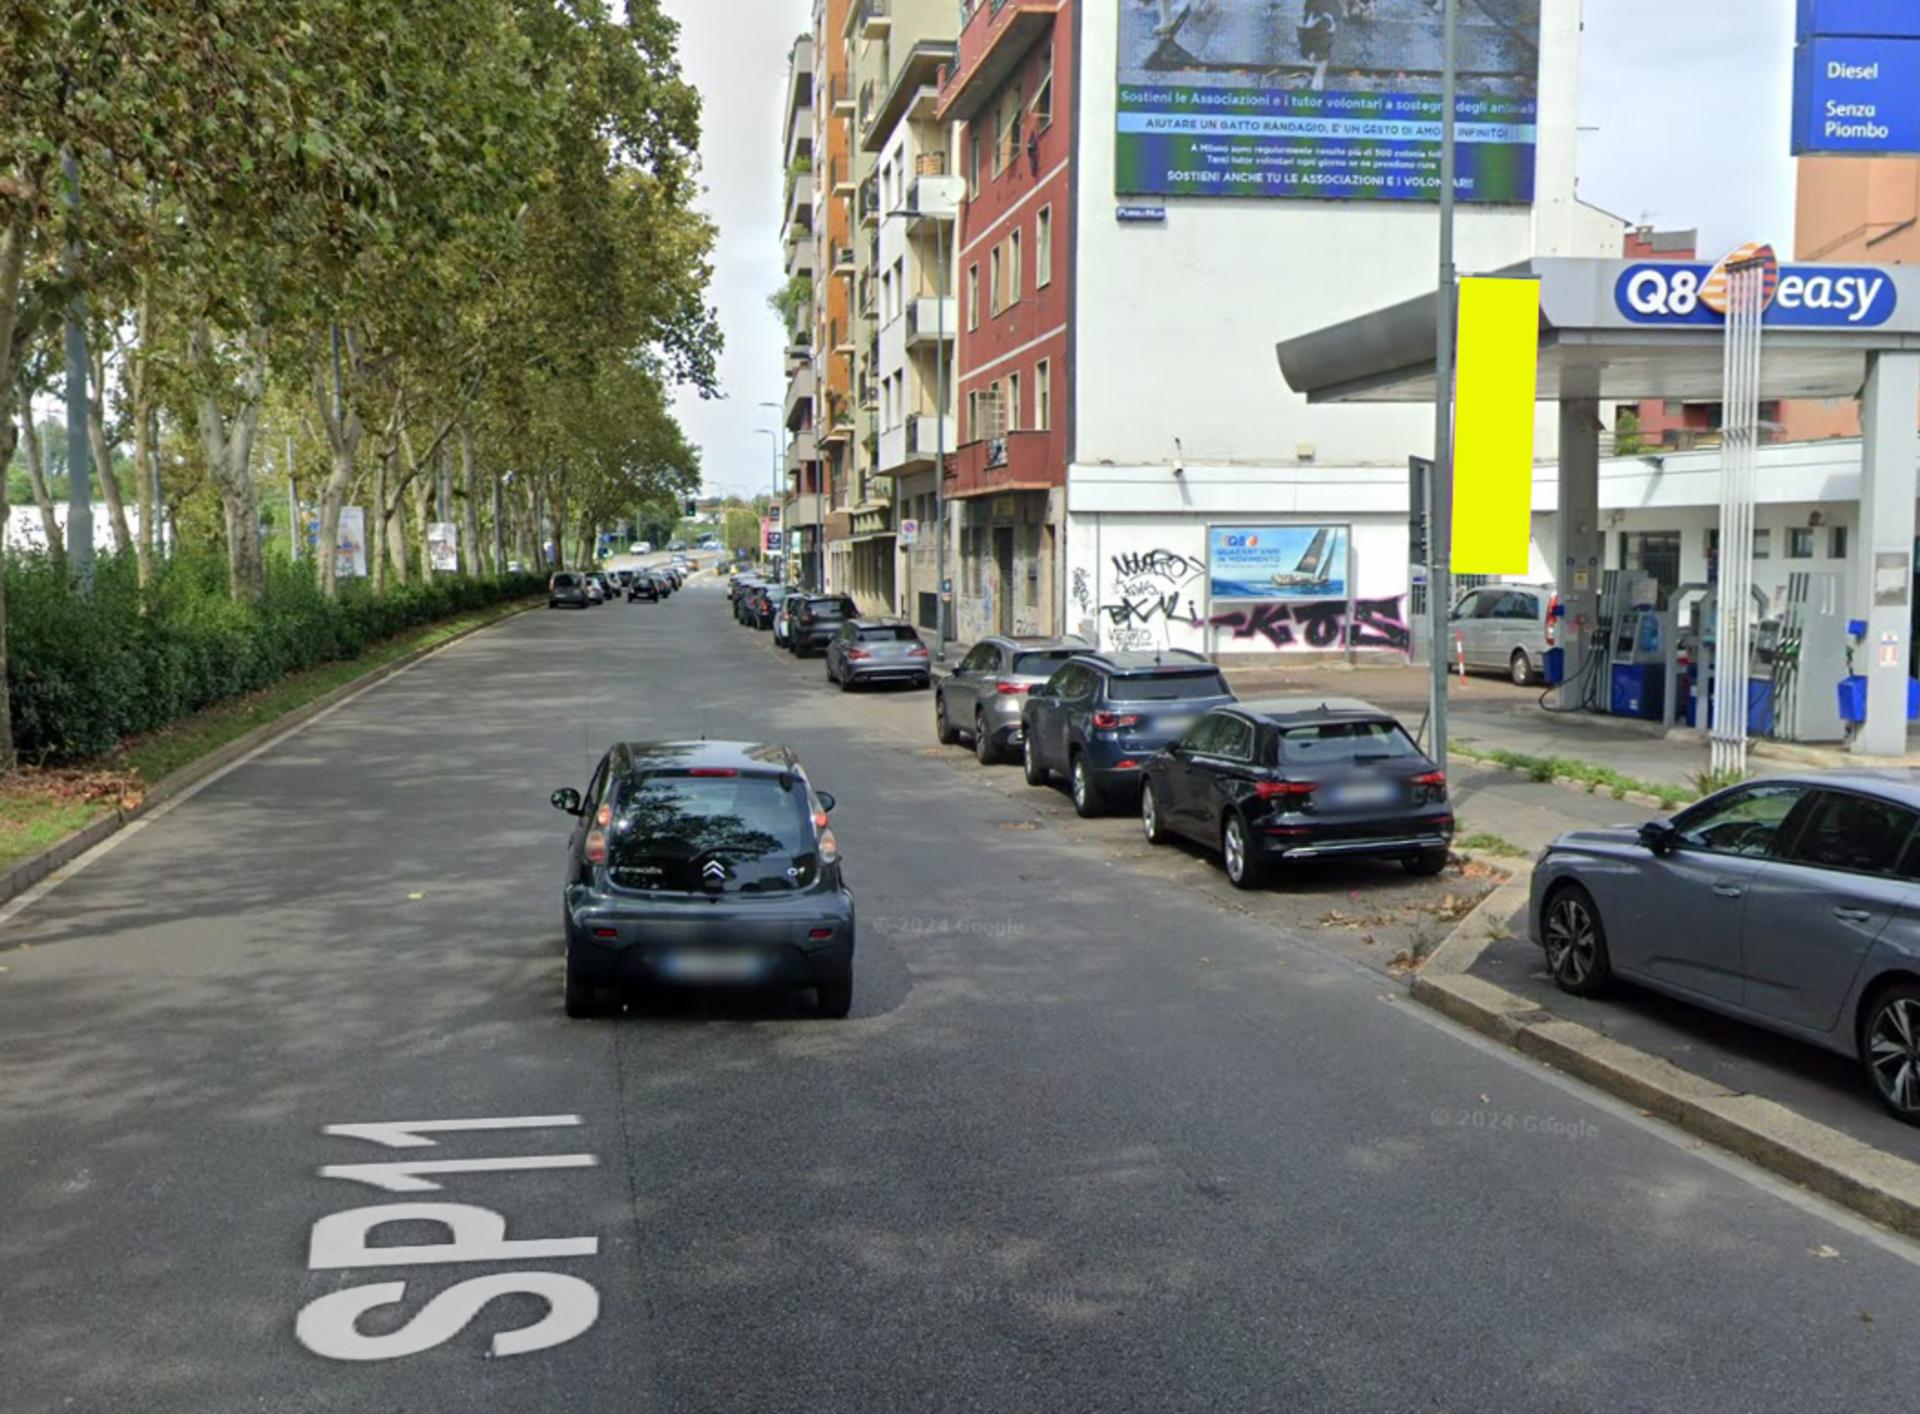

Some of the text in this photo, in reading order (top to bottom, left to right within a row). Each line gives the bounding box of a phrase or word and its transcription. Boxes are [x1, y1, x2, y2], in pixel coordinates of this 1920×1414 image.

[1827, 61, 1879, 79] Diesel
[1121, 90, 1172, 104] Sostieni
[1175, 91, 1188, 104] le
[1190, 92, 1270, 107] Associazioni
[1291, 97, 1324, 108] tutor
[1326, 97, 1383, 109] volontari
[1396, 100, 1443, 114] sostegn
[1456, 100, 1487, 115] degli
[1825, 100, 1876, 117] Senza
[1145, 118, 1198, 129] AIUTARE
[1200, 119, 1217, 130] UN
[1219, 120, 1260, 131] GATTO
[1344, 124, 1360, 134] UN
[1362, 124, 1399, 136] GESTO
[1401, 125, 1413, 136] DI
[1415, 126, 1442, 137] AMO
[1824, 121, 1889, 139] Piombo
[1167, 170, 1220, 182] SOSTIENI
[1222, 171, 1263, 183] ANCHE
[1266, 172, 1281, 184] TU
[1284, 173, 1298, 184] LE
[1301, 173, 1384, 186] ASSOCIAZIONI
[1626, 268, 1883, 322] Q8 easy
[296, 1114, 599, 1360] SP11
